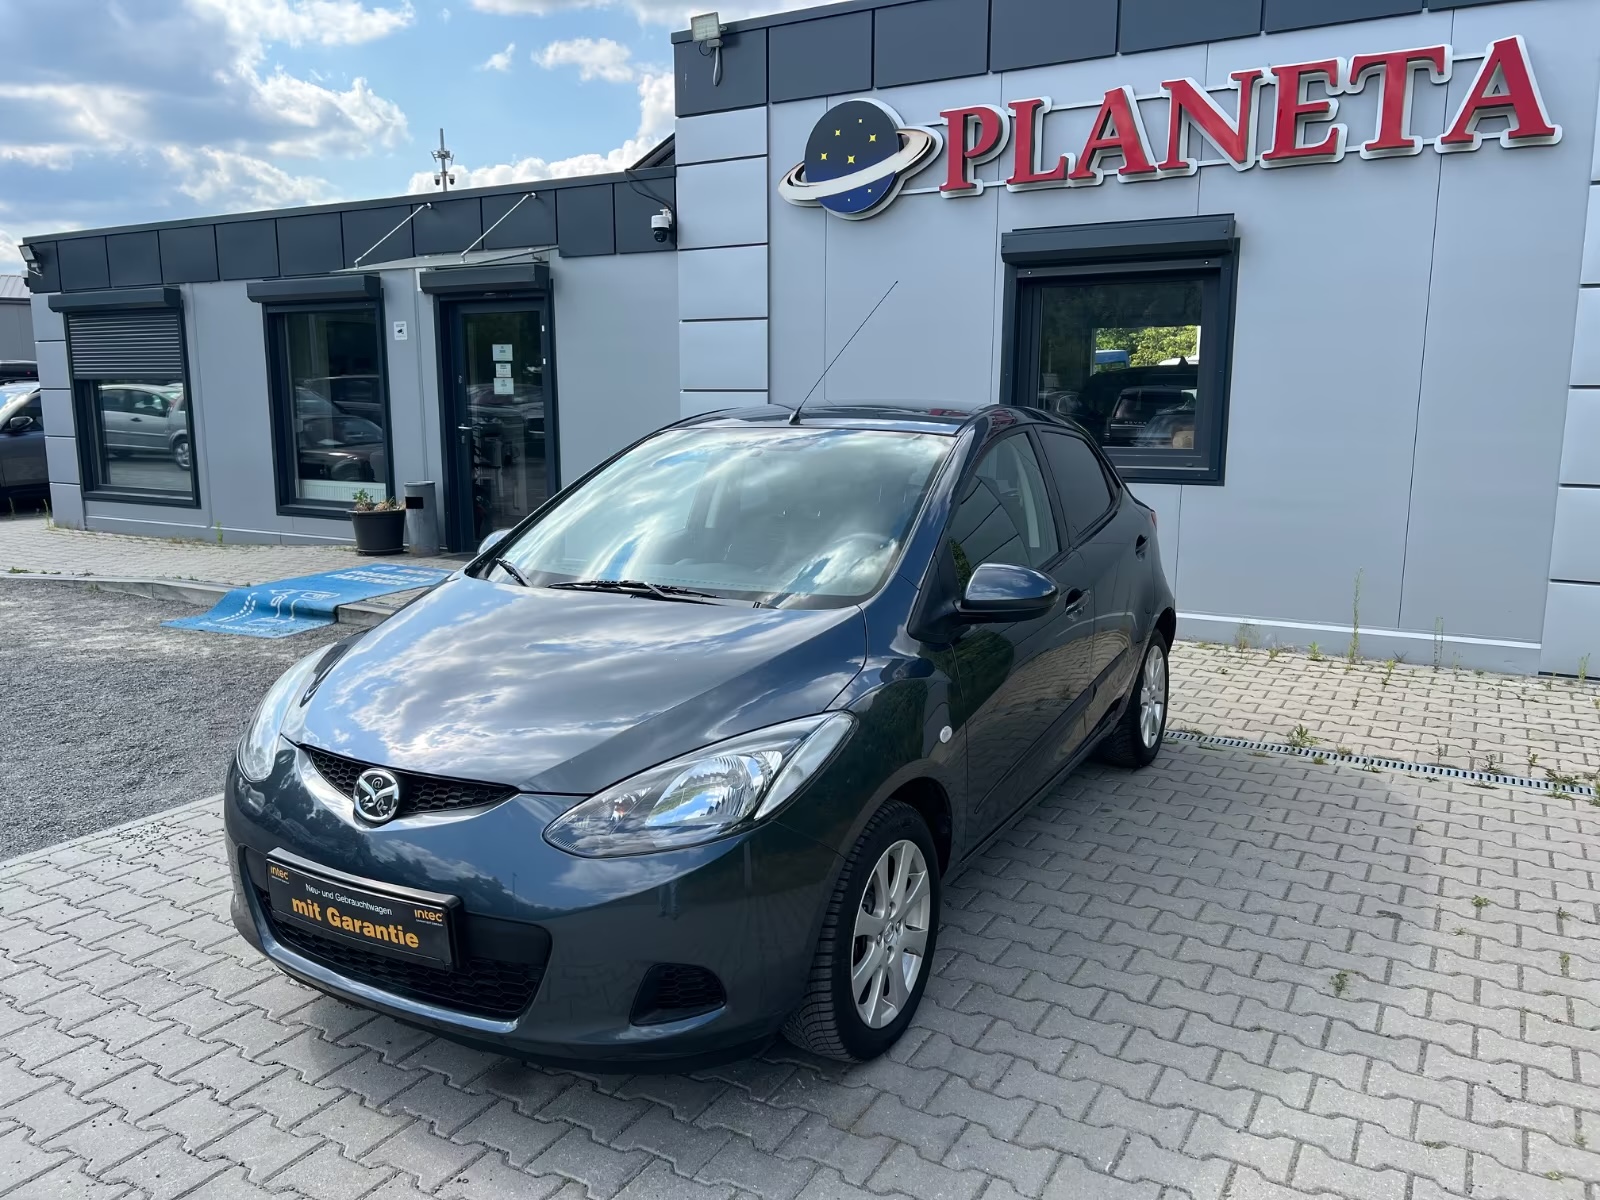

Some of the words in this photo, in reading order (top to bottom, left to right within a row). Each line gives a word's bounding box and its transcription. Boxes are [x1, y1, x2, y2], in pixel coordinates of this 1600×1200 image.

[940, 36, 1558, 194] PLANETA
[291, 898, 321, 921] mit
[326, 906, 419, 948] Garantie
[305, 883, 321, 895] Neu-
[321, 890, 334, 900] und
[335, 893, 392, 915] Gebrauchtwagen
